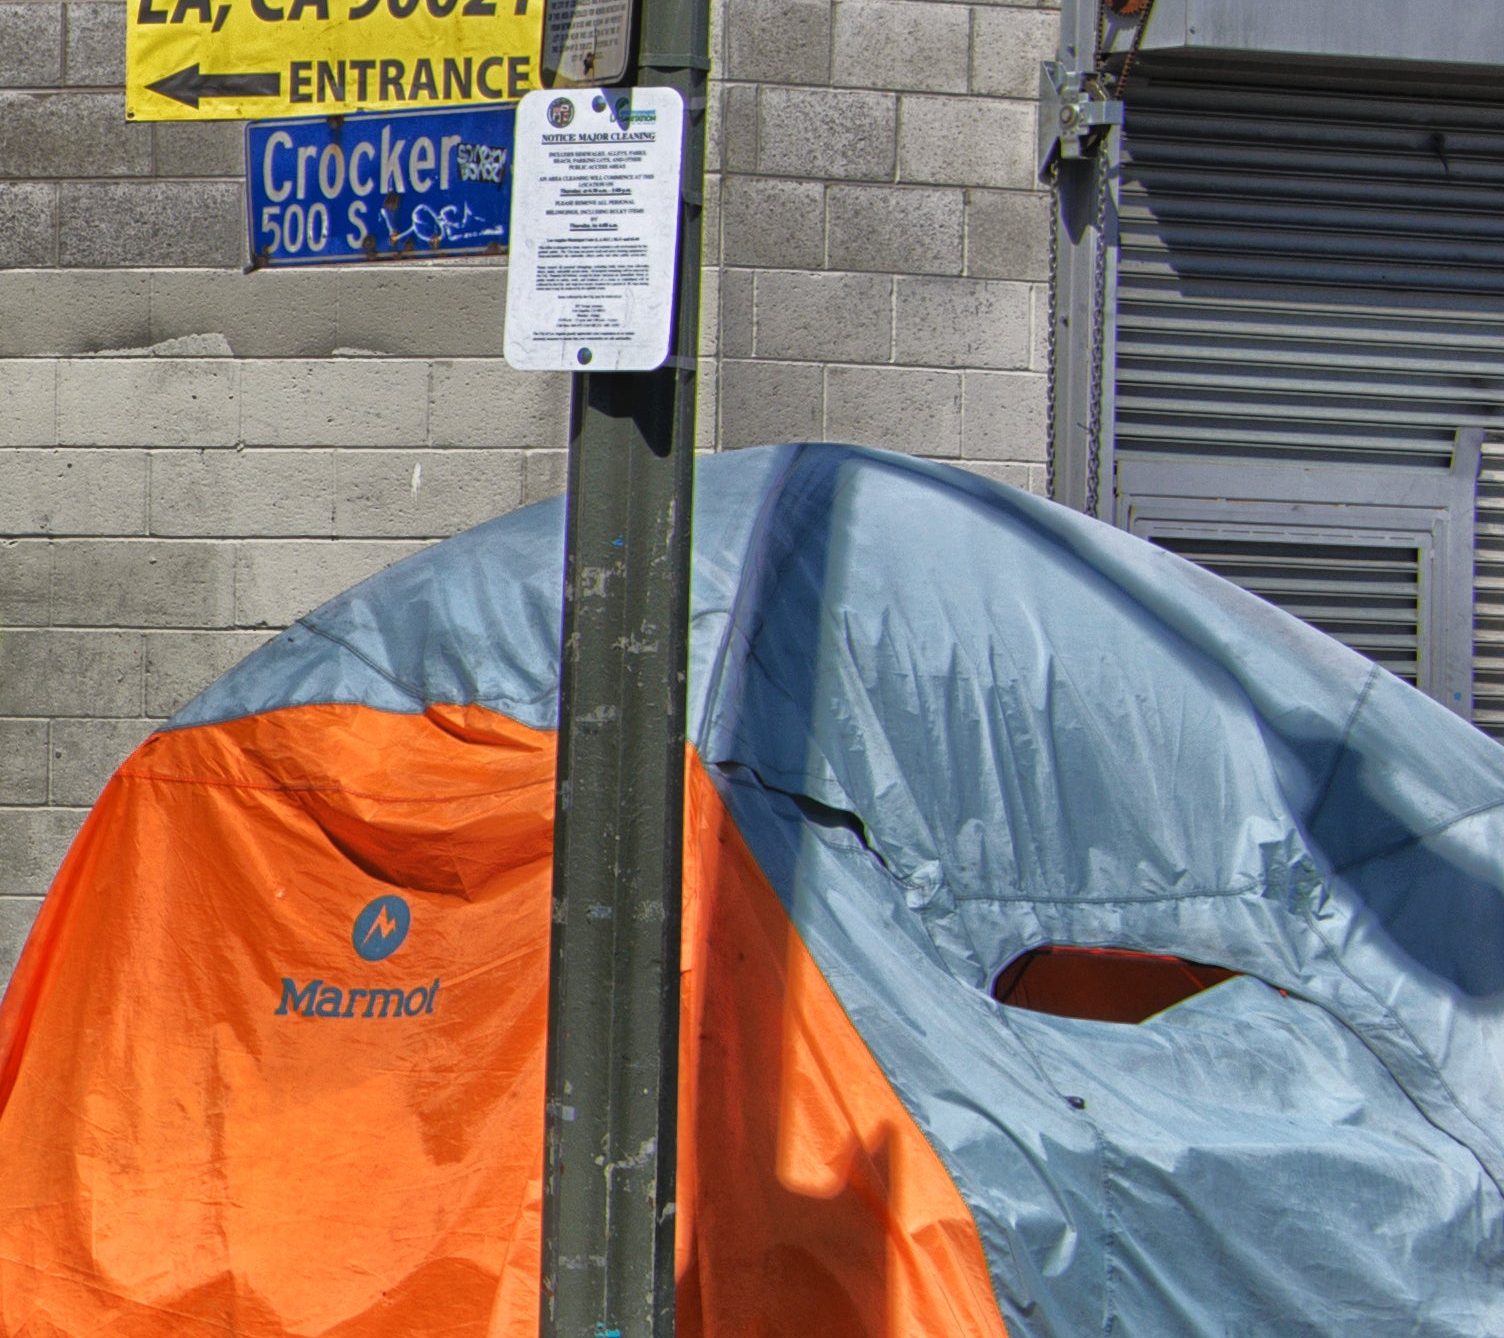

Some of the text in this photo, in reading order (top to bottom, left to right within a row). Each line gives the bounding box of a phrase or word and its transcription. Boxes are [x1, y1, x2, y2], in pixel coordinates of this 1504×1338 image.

[289, 56, 531, 105] ENTRANCE
[578, 133, 609, 142] MAJOR
[610, 132, 655, 142] CLEANING
[263, 124, 462, 204] Crocker
[261, 204, 328, 254] 500
[347, 202, 368, 250] S
[273, 976, 441, 1019] Marmot
